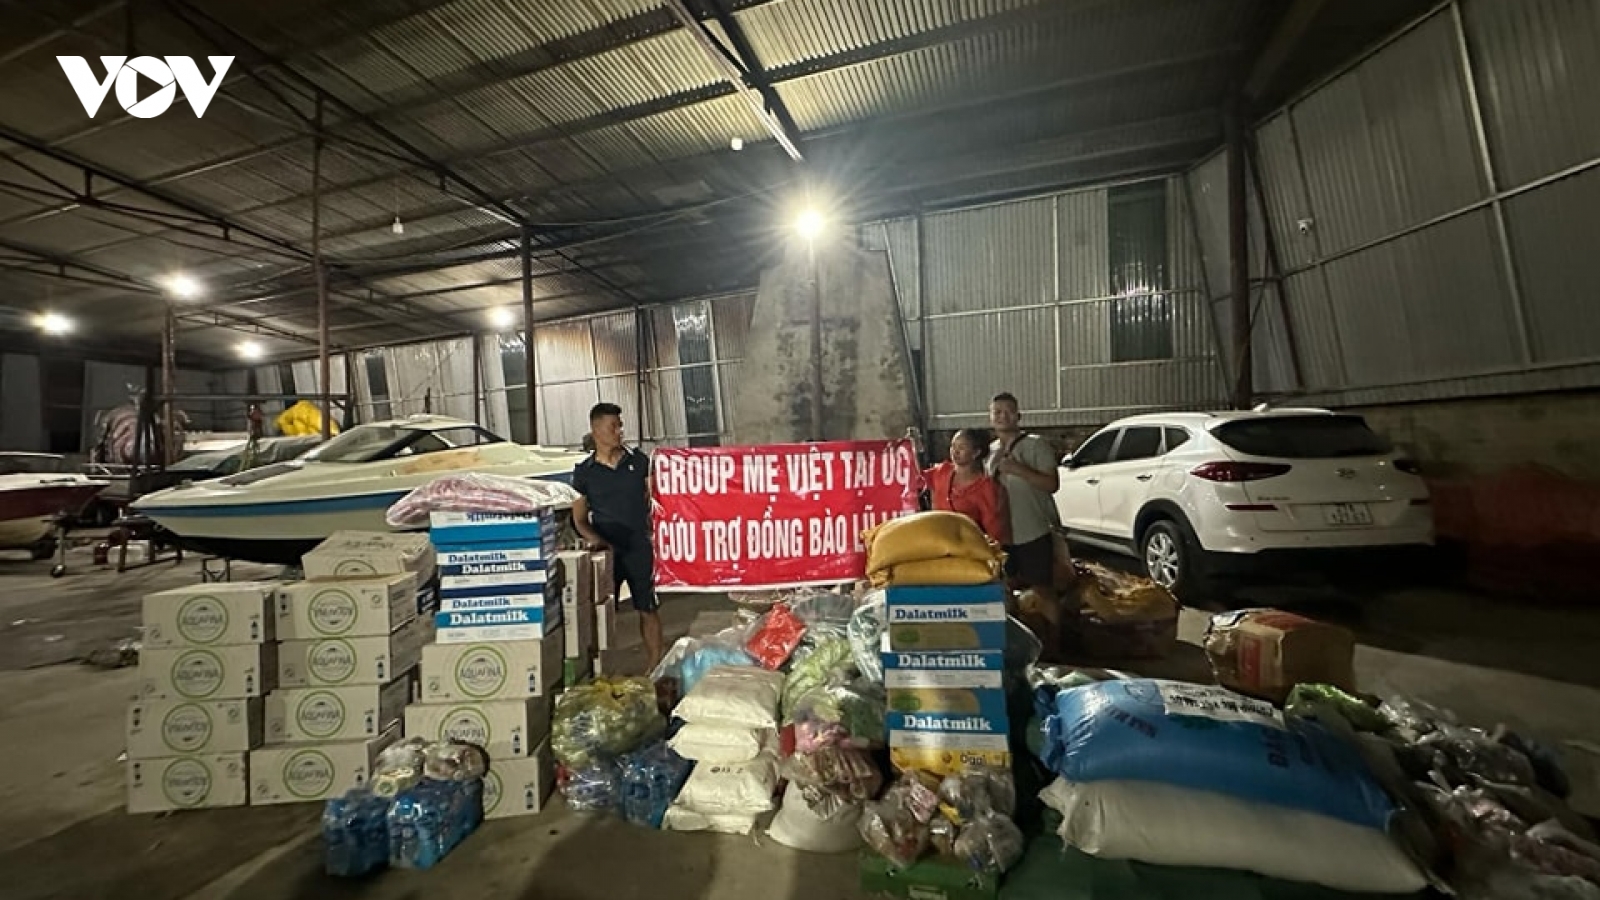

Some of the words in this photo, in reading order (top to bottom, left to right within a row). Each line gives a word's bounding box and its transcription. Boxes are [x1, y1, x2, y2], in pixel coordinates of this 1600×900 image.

[654, 454, 735, 495] GROUP
[743, 454, 780, 502] MẸ
[785, 446, 834, 500] VIỆT
[840, 451, 876, 497] TẠI
[658, 513, 696, 562] CỨU
[701, 516, 741, 570] TRỢ
[809, 508, 847, 557] BÀO
[448, 553, 507, 563] Dalatmilk
[461, 562, 526, 574] Dalatmilk
[453, 598, 510, 609] Dalatmilk
[450, 610, 529, 625] Dalatmilk
[895, 608, 968, 619] Dalatmilk
[898, 654, 986, 668] Dalatmilk
[460, 666, 501, 679] AQUAFINA
[904, 715, 992, 731] Dalatmilk
